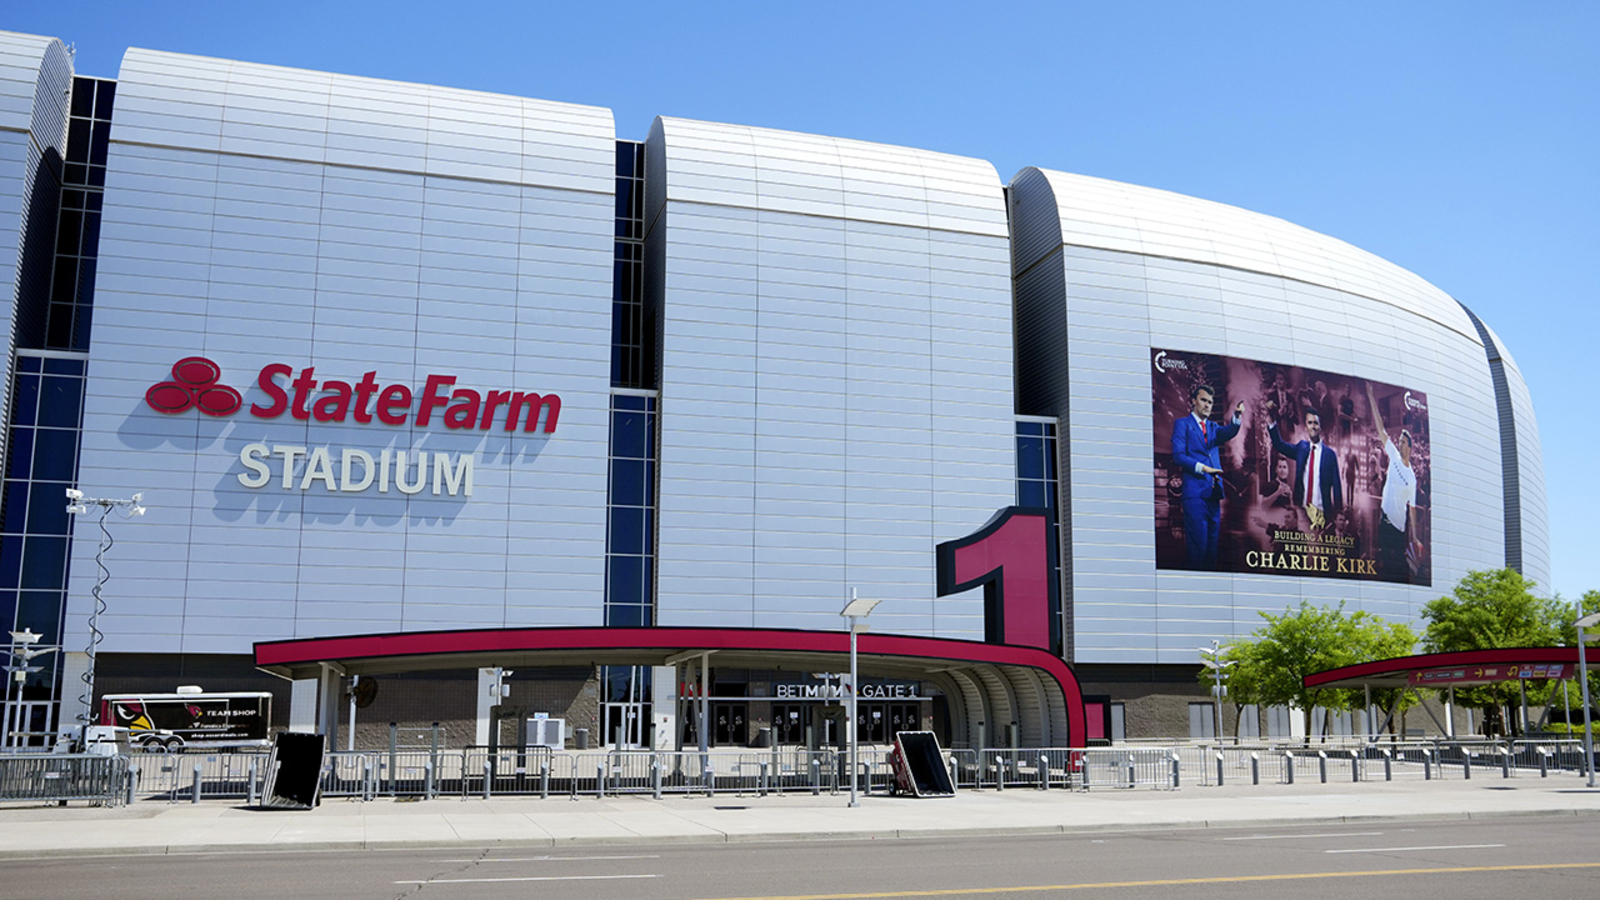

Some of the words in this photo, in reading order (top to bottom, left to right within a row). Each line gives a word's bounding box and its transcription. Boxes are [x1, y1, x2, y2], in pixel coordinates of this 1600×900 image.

[237, 443, 474, 496] STADIUM
[1274, 530, 1315, 542] BUILDING
[1318, 534, 1324, 542] A
[1325, 534, 1355, 545] LEGACY
[1284, 544, 1346, 555] REMEMBERING
[1246, 550, 1330, 571] CHARLIE
[1335, 557, 1378, 575] KIRK
[936, 505, 1061, 655] 1
[862, 684, 905, 698] GATE
[908, 684, 917, 698] 1
